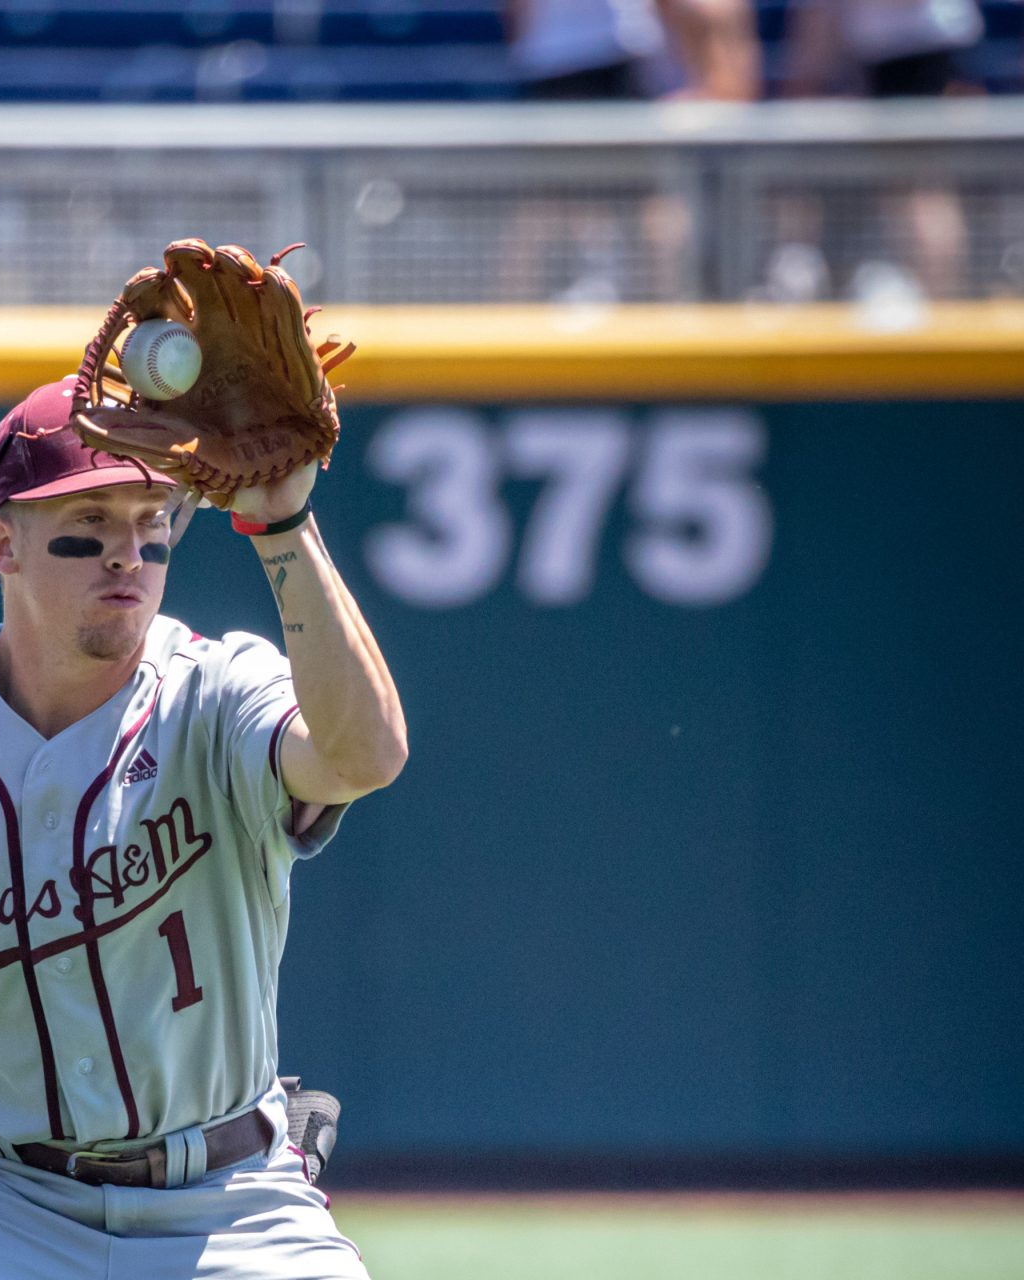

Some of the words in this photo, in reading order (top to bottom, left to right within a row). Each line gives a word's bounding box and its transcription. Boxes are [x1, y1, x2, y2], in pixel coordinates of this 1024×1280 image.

[361, 410, 773, 606] 375
[69, 797, 212, 922] A&M
[158, 910, 203, 1012] 1
